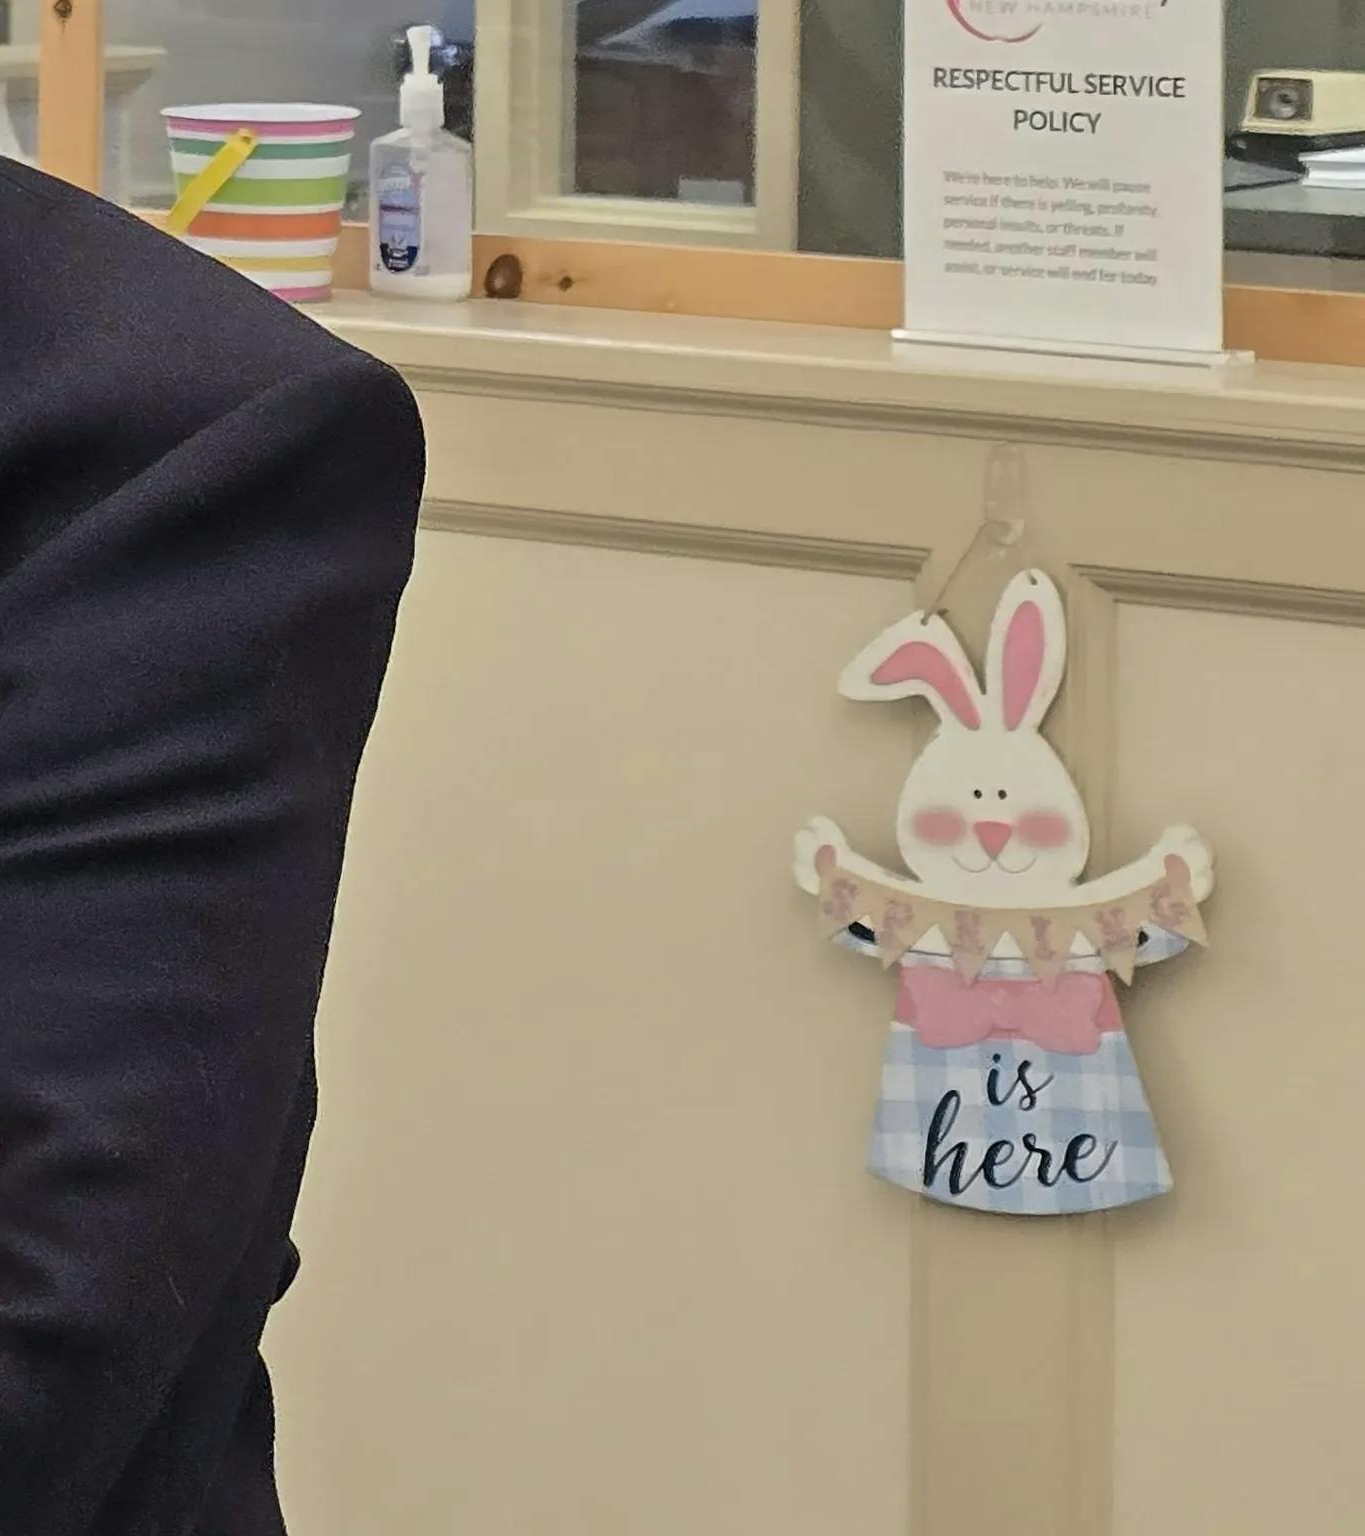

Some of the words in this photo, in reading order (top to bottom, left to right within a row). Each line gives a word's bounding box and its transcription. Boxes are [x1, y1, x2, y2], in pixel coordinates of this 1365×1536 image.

[969, 0, 1018, 15] NEW
[1026, 1, 1153, 20] HAMPSHIRE
[932, 67, 1080, 94] RESPECTFUL
[1084, 72, 1187, 98] SERVICE
[1012, 109, 1102, 134] POLICY
[985, 1052, 1055, 1112] is
[922, 1088, 1118, 1197] here
